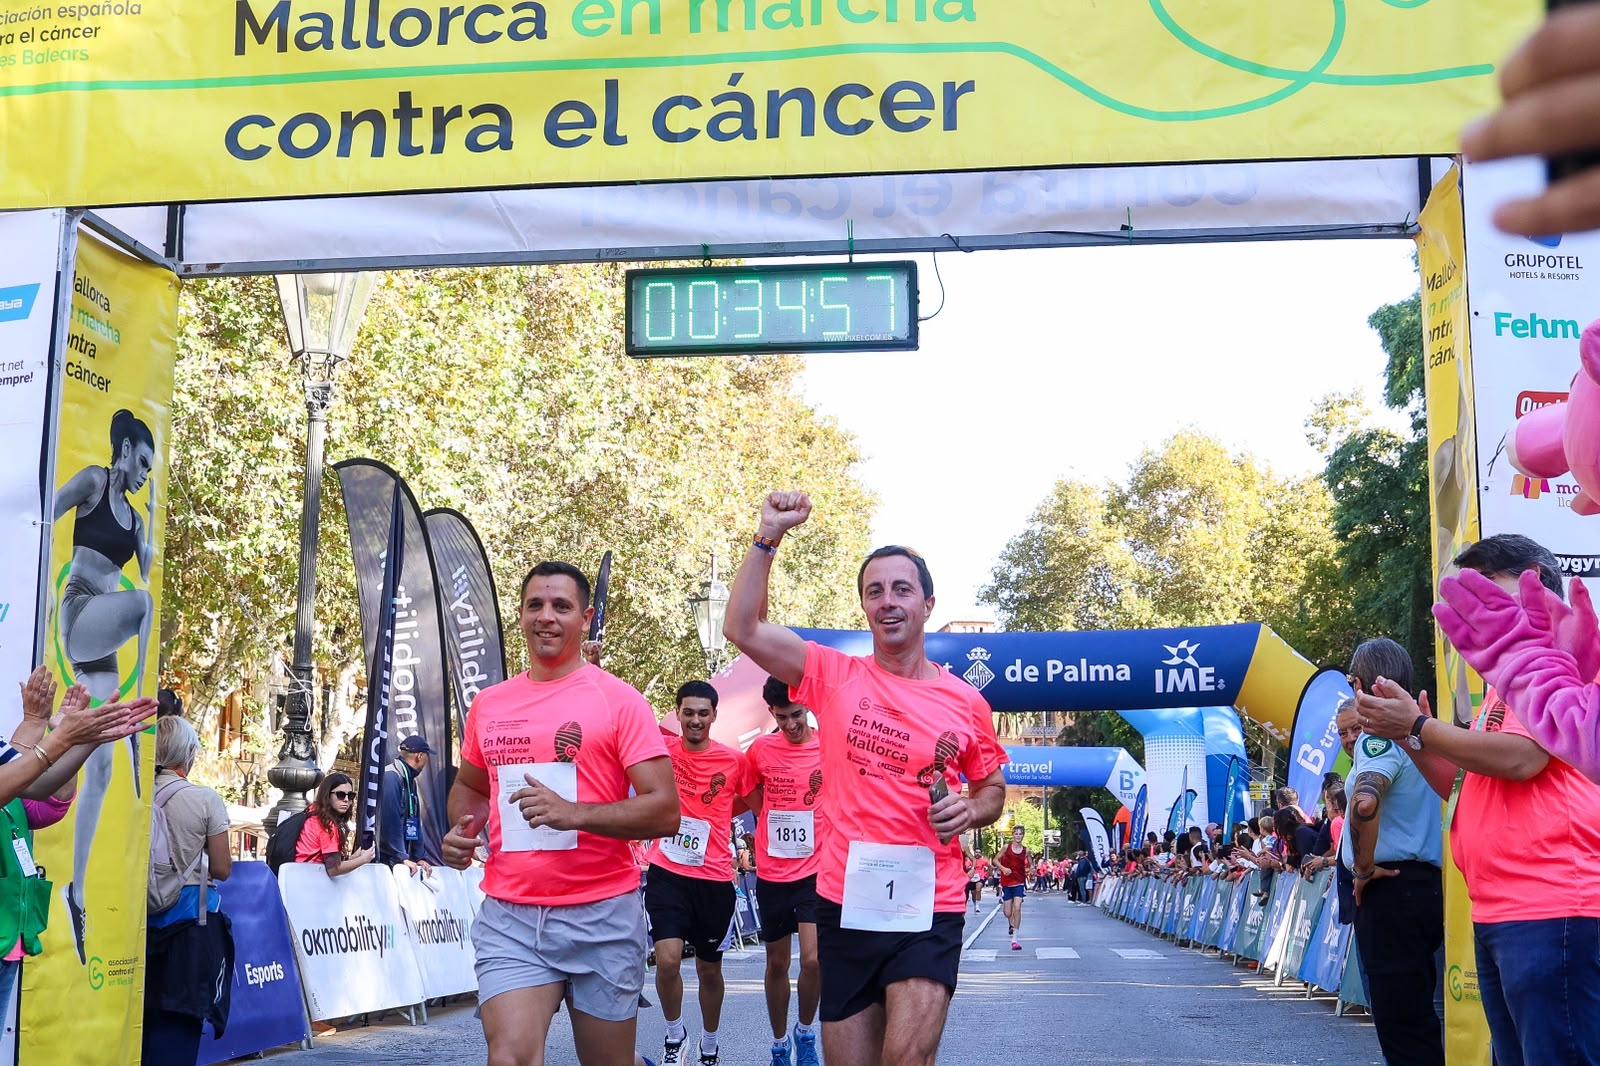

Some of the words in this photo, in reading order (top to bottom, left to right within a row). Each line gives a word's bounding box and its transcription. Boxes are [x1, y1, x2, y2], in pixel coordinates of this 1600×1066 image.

[57, 0, 142, 20] española
[20, 27, 35, 43] el
[39, 25, 101, 42] cáncer
[234, 0, 547, 56] Mallorca
[571, 0, 662, 37] en
[22, 48, 89, 65] Balears
[225, 91, 514, 161] contra
[543, 79, 628, 148] el
[652, 72, 976, 143] cáncer
[1504, 253, 1584, 270] GRUPOTEL
[1509, 272, 1539, 280] HOTELS
[1547, 273, 1580, 281] RESORTS
[645, 275, 896, 341] 00:34:57
[77, 308, 121, 345] marcha
[823, 333, 894, 342] WWW.PIXELCOM.ES
[1494, 312, 1581, 340] Fehm
[8, 360, 24, 372] net
[1429, 345, 1456, 370] cán
[65, 360, 112, 393] cáncer
[1005, 659, 1039, 683] de
[1047, 658, 1132, 682] Palma
[1155, 666, 1215, 693] IME
[849, 727, 871, 739] contra
[852, 714, 868, 728] En
[870, 720, 911, 742] Marxa
[496, 736, 531, 746] Marxa
[846, 732, 909, 764] Mallorca
[1009, 760, 1054, 774] travel
[1120, 770, 1135, 791] B
[776, 826, 807, 843] 1813
[885, 880, 894, 900] 1
[302, 916, 384, 959] okmobility
[244, 960, 285, 989] Esports
